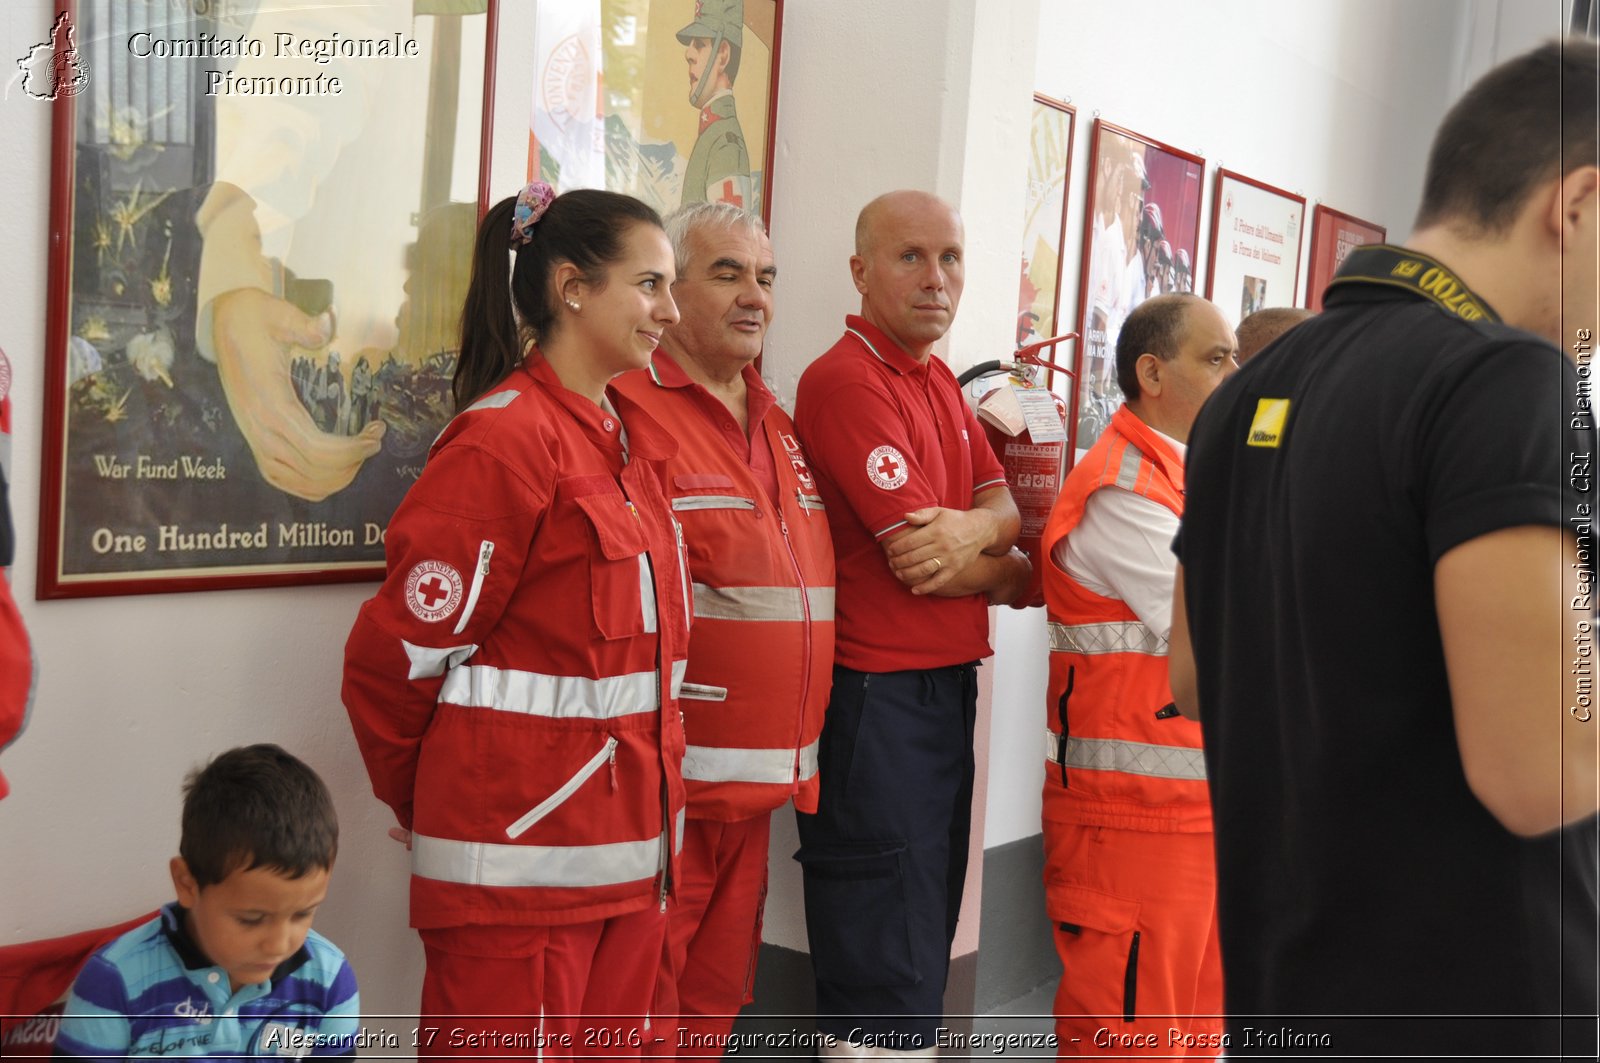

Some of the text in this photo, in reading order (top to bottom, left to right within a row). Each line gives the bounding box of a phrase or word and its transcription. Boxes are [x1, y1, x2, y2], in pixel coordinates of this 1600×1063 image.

[1419, 268, 1482, 321] D700
[1251, 431, 1277, 442] Nikon
[94, 454, 226, 479] War Fund Week
[92, 528, 146, 554] One
[158, 523, 268, 551] Hundred
[278, 523, 354, 548] Million
